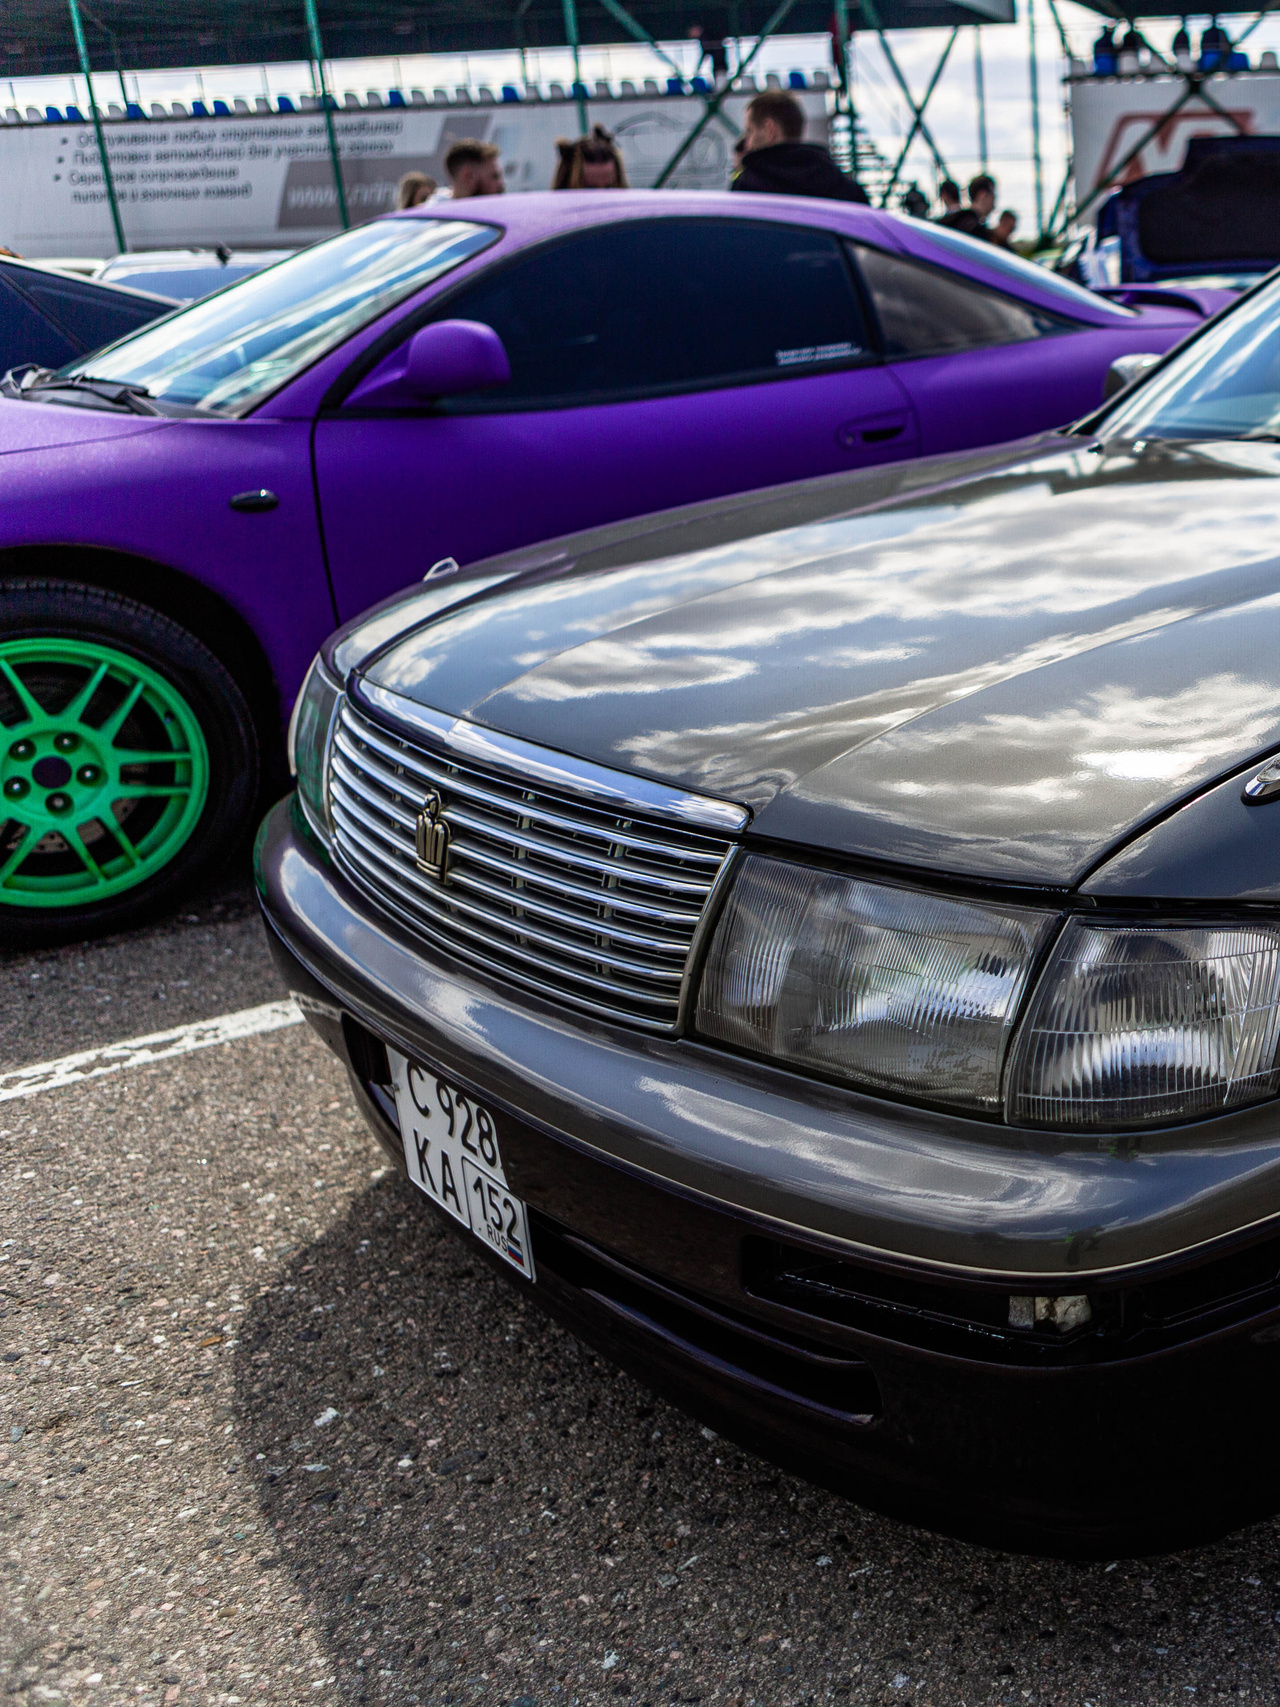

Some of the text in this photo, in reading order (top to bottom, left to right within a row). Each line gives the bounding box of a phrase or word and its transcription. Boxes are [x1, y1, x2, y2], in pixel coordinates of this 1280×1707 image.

[436, 1081, 497, 1167] 928
[473, 1176, 521, 1247] 152
[487, 1224, 508, 1251] RUS
